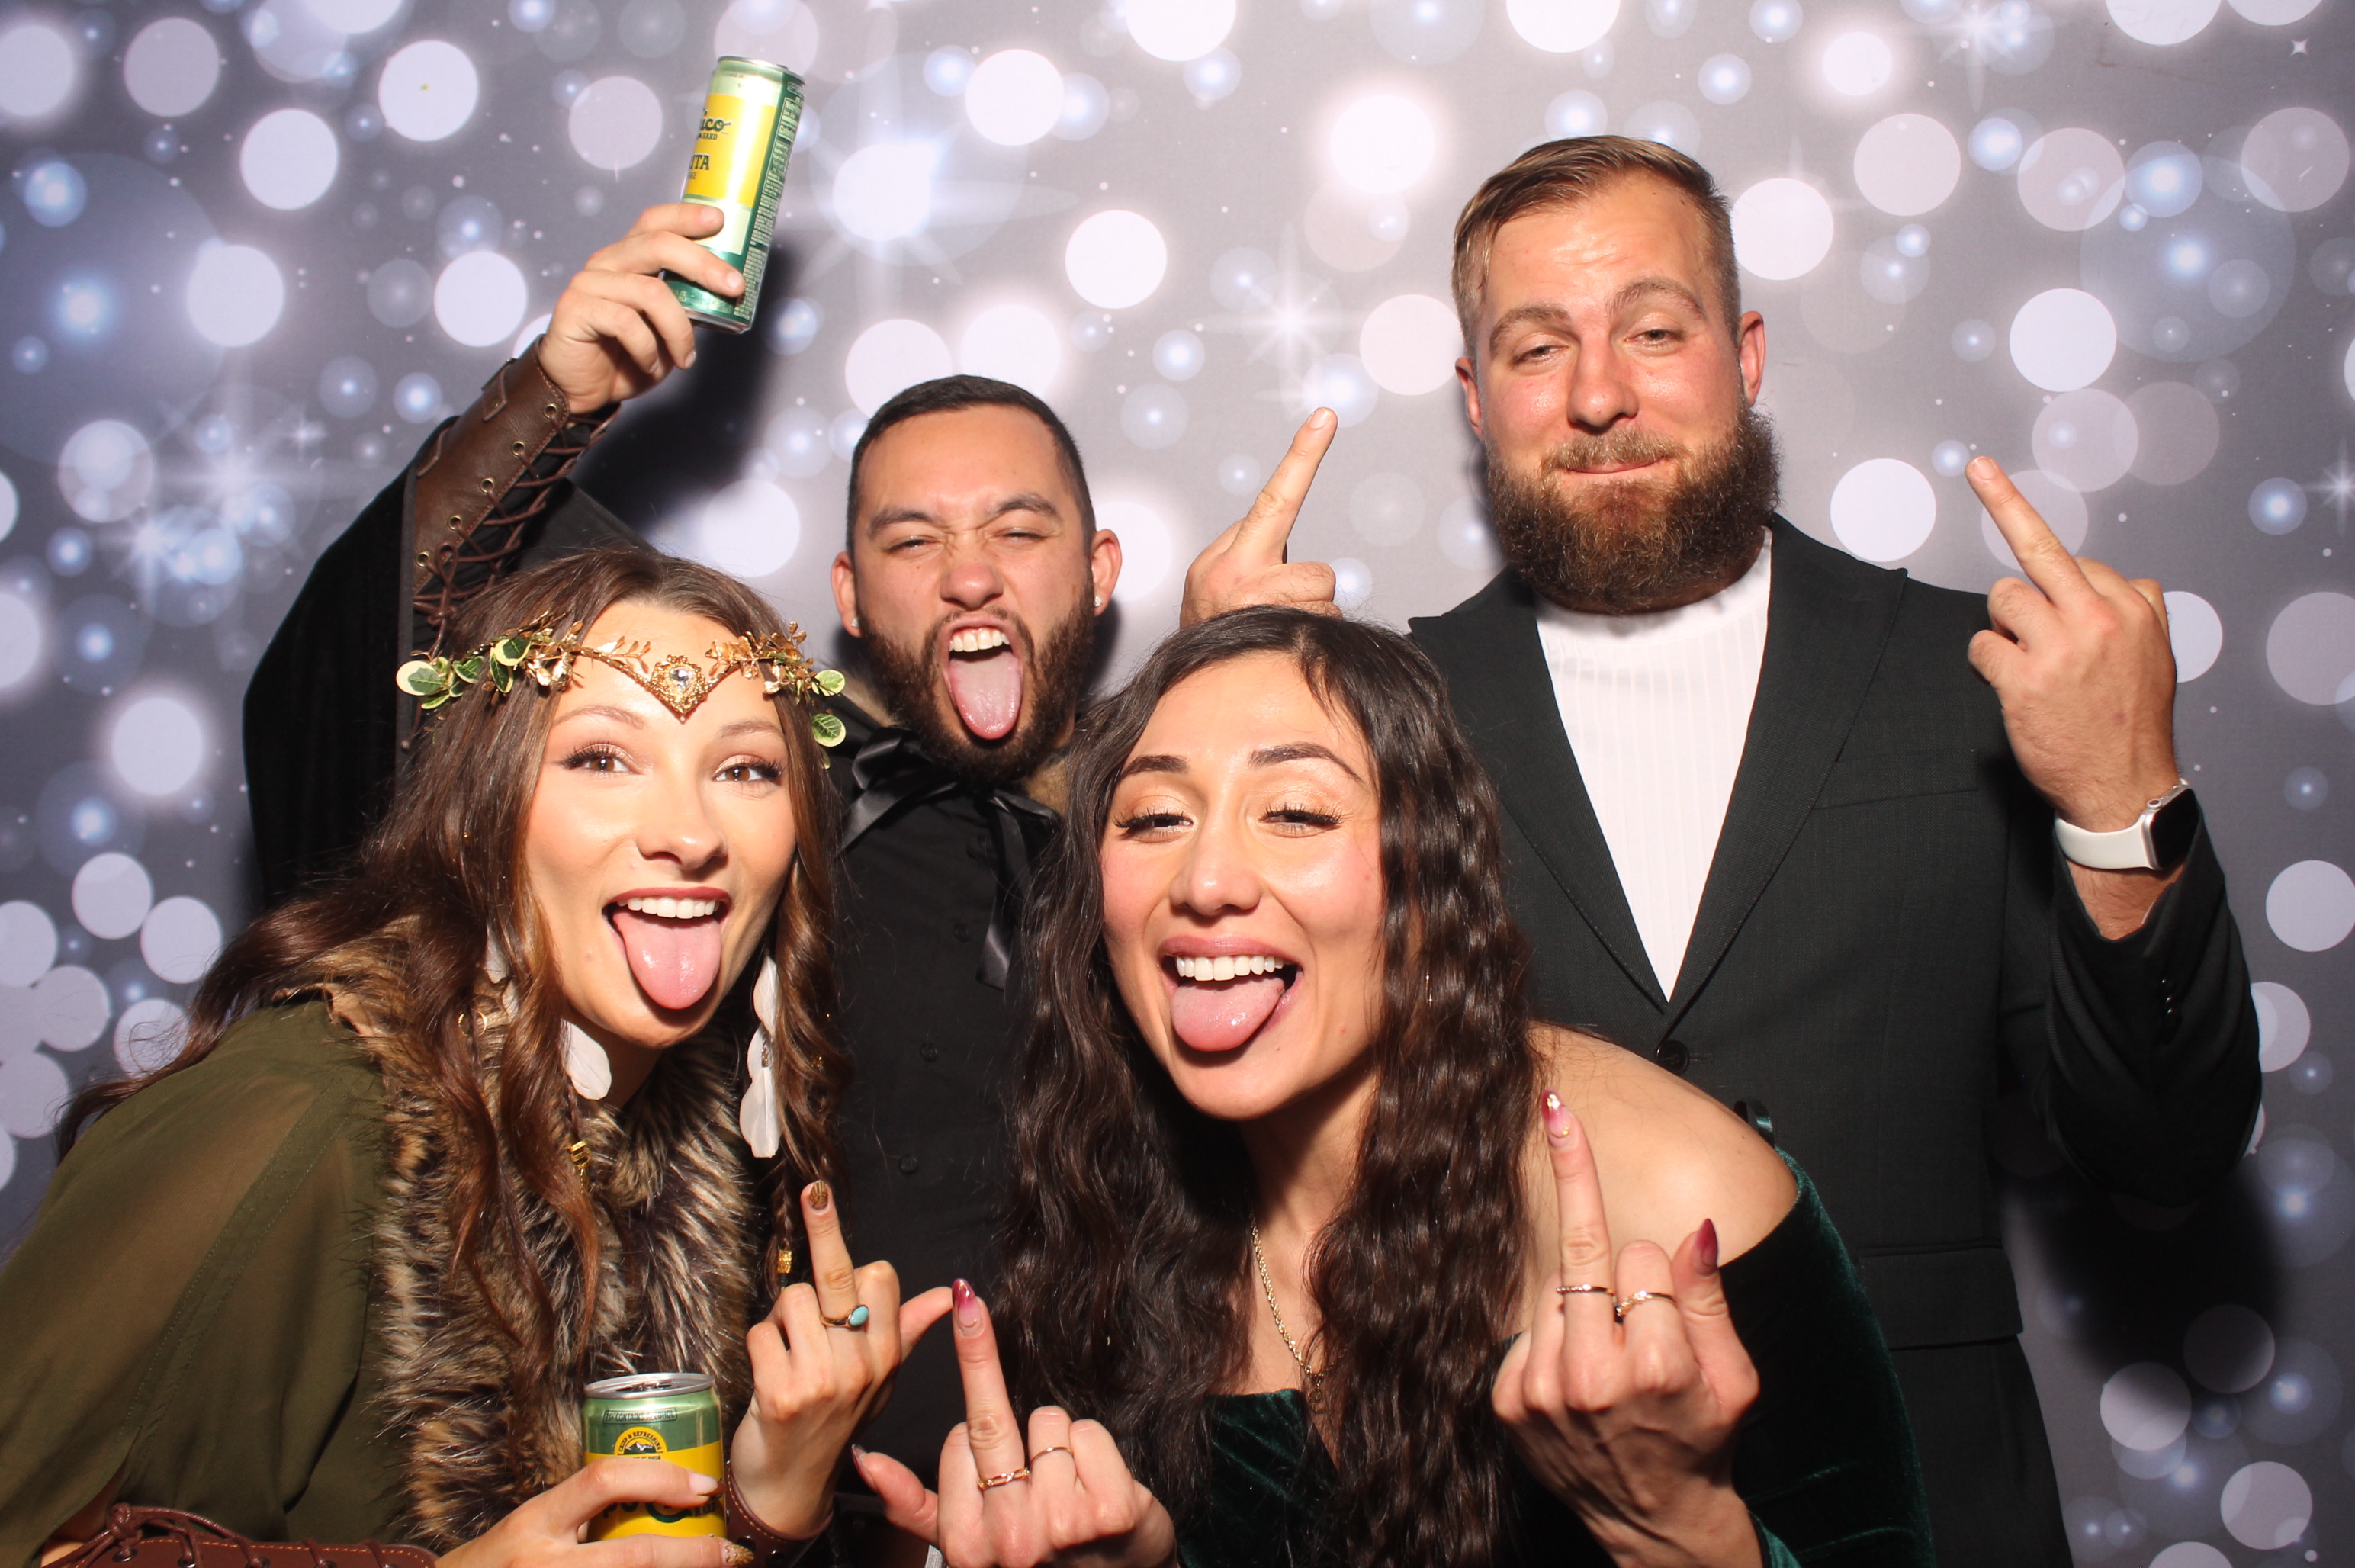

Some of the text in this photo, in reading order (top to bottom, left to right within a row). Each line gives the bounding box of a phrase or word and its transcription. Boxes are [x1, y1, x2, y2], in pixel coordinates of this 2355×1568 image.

[689, 153, 709, 170] ITA
[615, 1412, 644, 1422] CONTAINS
[632, 1431, 662, 1451] REFRESHING
